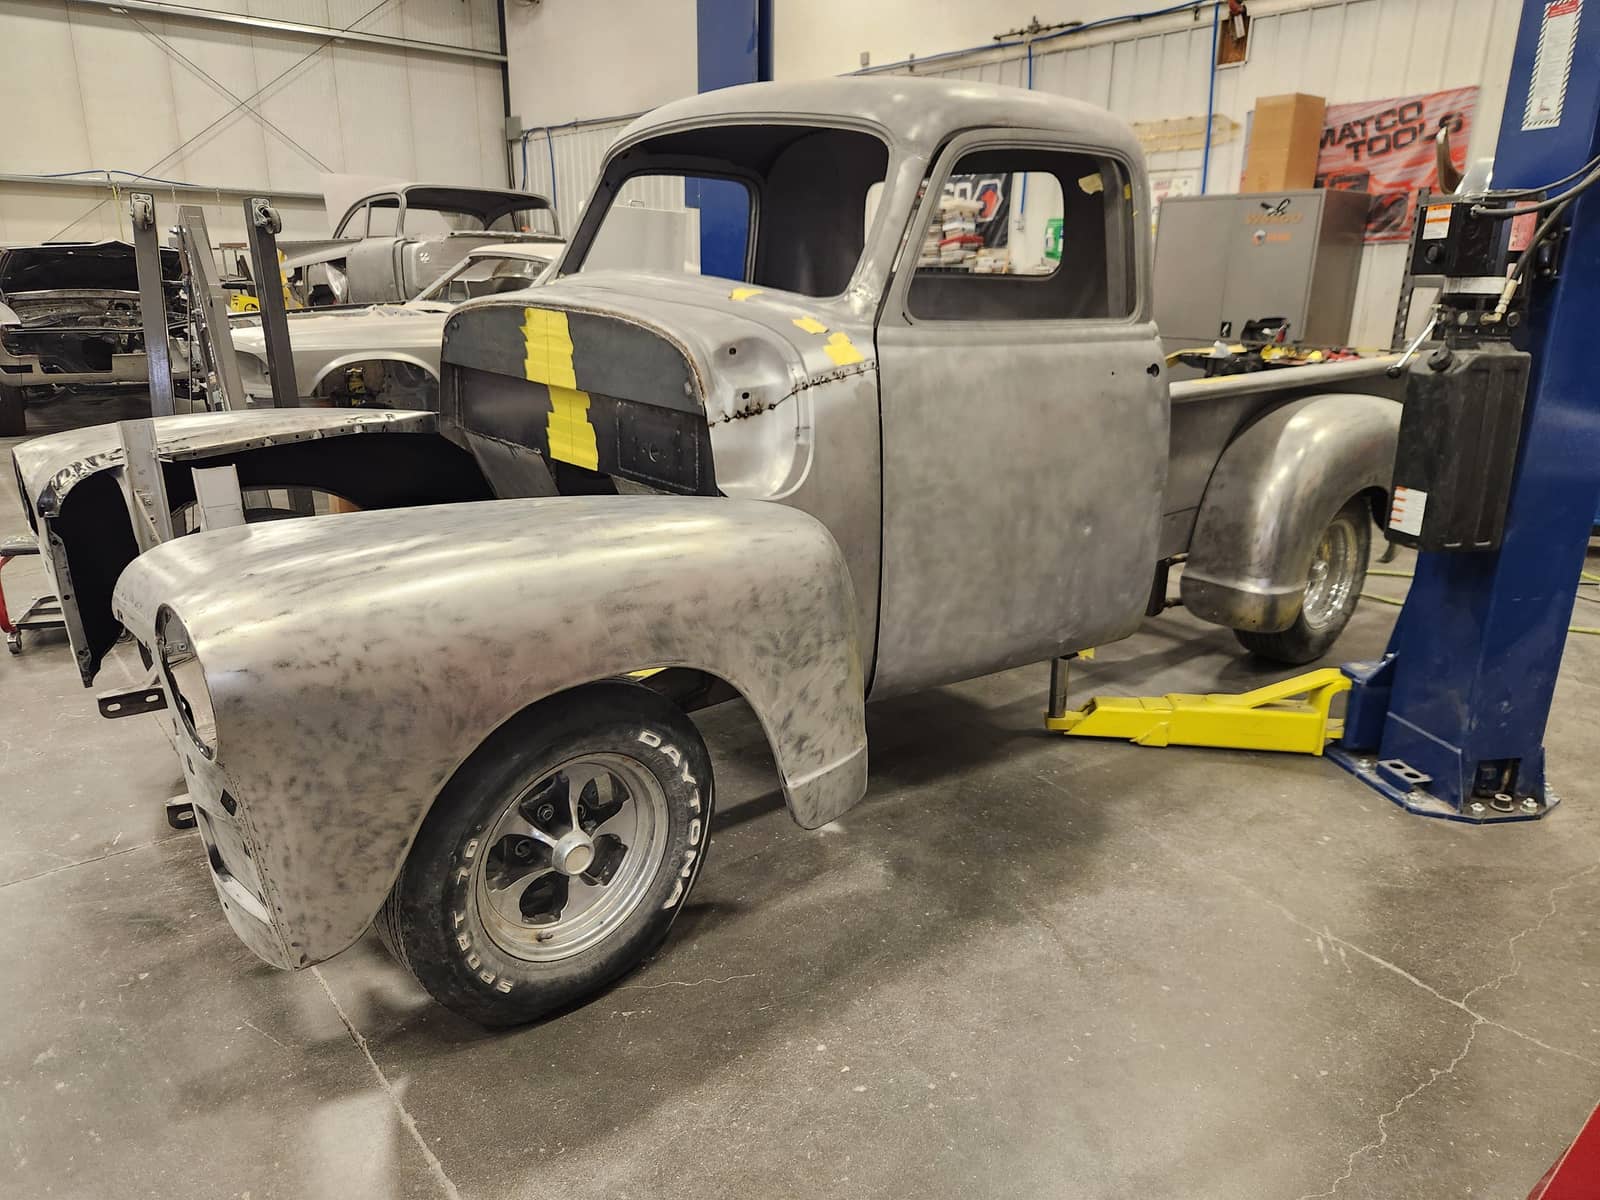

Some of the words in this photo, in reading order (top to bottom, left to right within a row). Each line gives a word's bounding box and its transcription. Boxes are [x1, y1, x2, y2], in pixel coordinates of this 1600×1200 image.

[1319, 101, 1424, 149] MATCO
[1345, 112, 1464, 161] TOOLS
[637, 729, 701, 910] DAYTONA
[453, 910, 514, 995] SPORT
